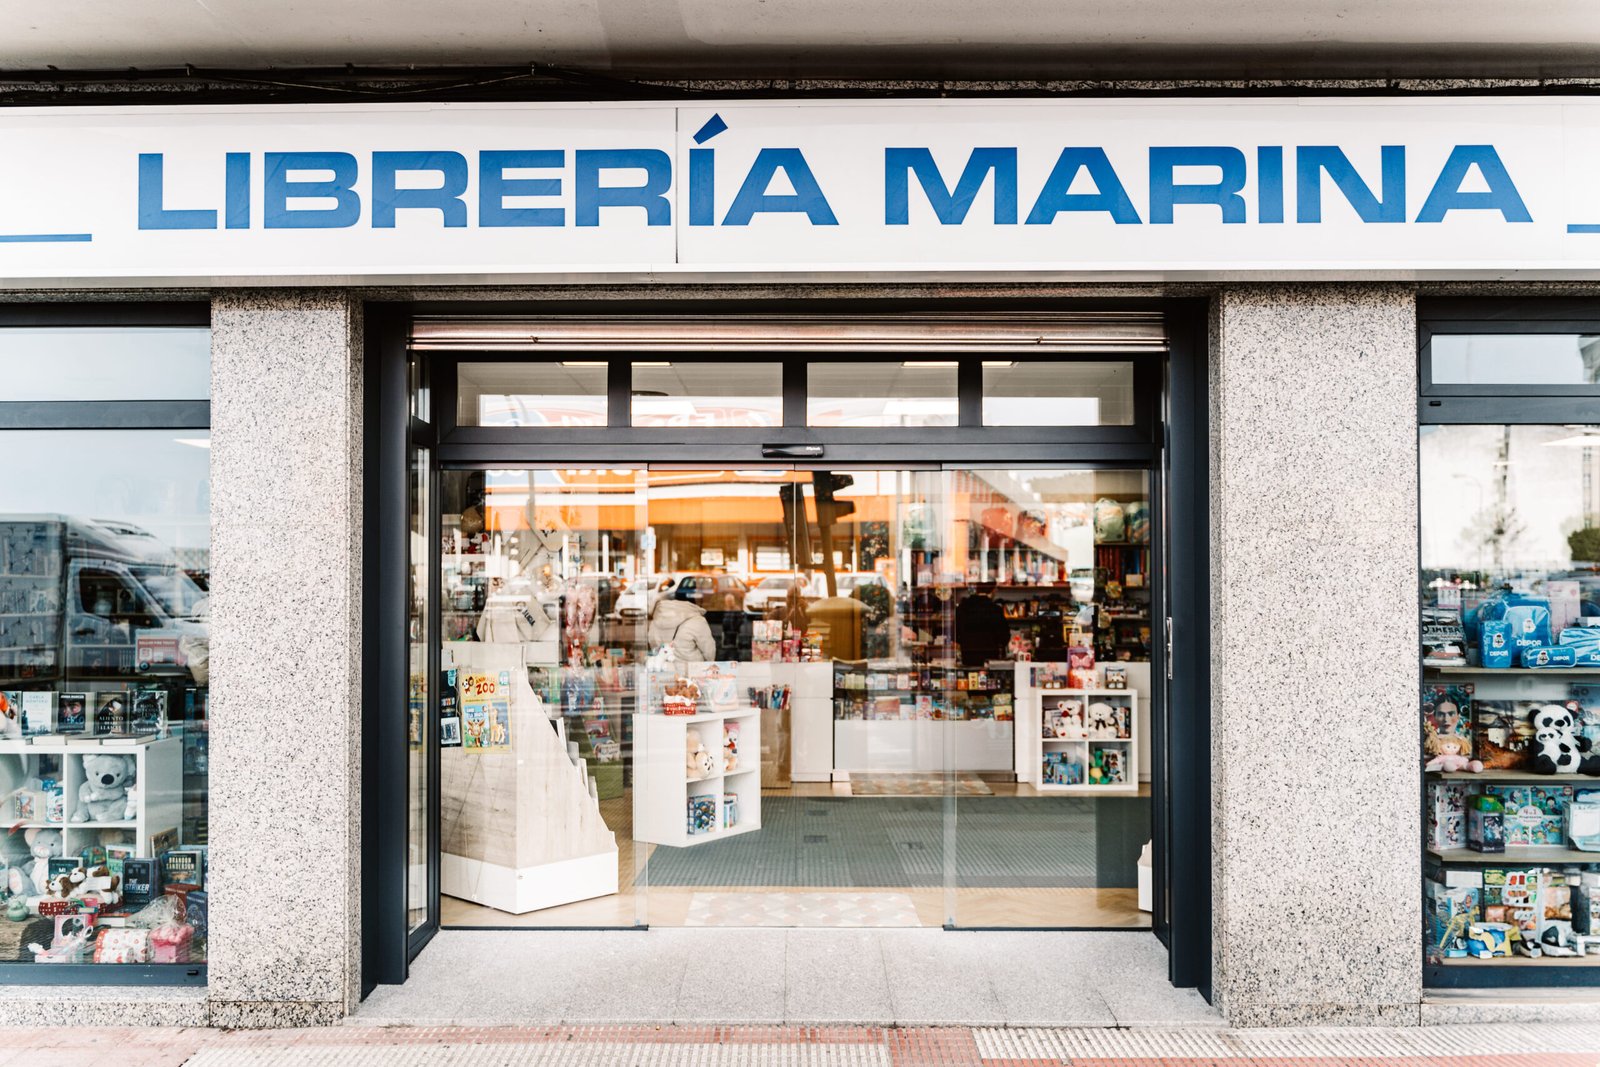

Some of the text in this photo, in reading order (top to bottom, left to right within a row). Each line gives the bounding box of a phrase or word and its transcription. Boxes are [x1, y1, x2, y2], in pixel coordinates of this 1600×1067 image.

[138, 113, 1533, 230] LIBRERÍA MARINA
[475, 682, 496, 695] ZOO
[124, 883, 150, 891] STRIKER
